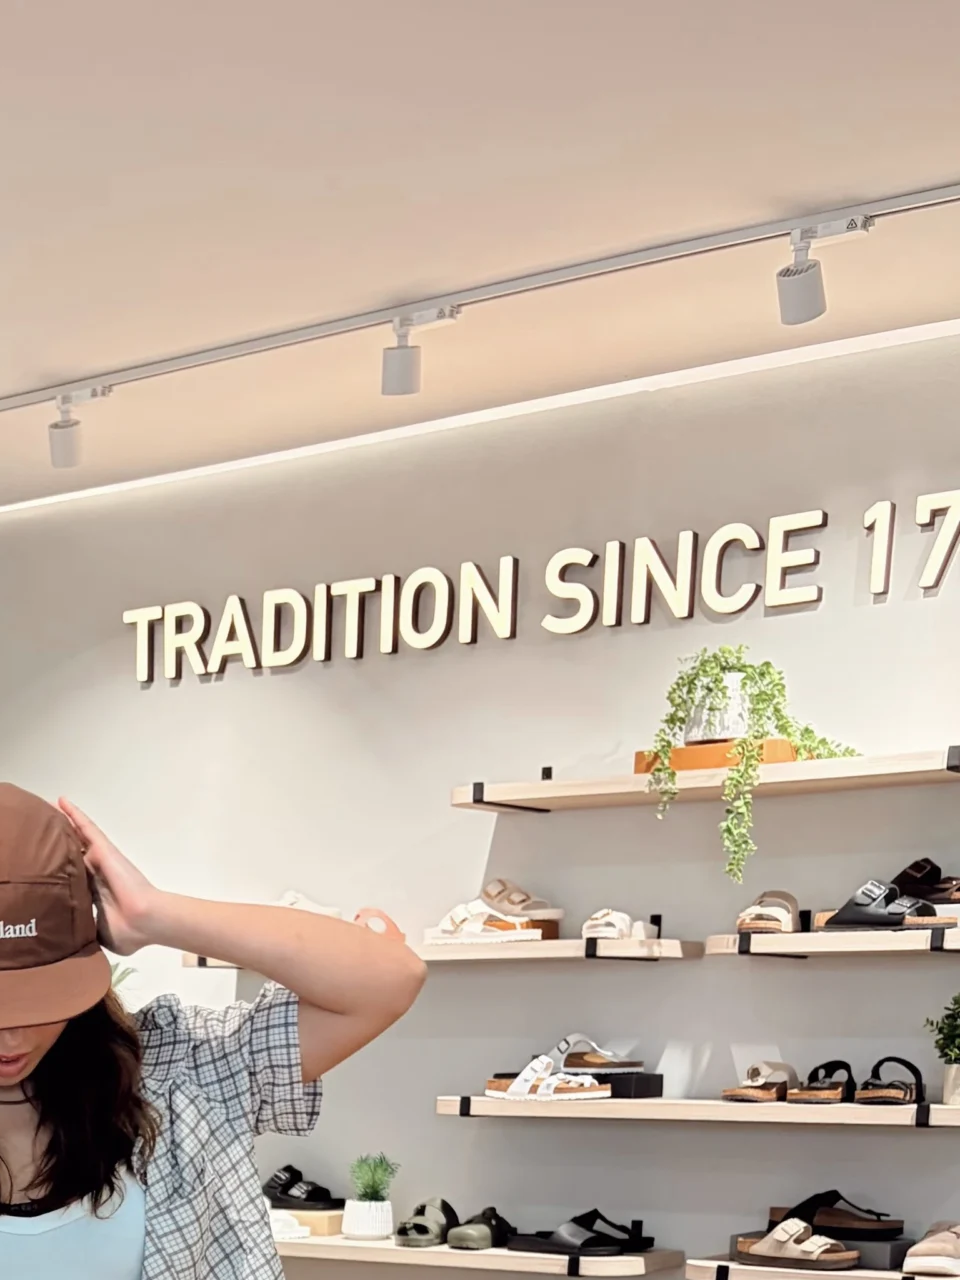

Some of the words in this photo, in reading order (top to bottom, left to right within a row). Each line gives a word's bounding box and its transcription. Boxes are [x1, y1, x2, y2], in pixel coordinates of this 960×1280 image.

[122, 555, 518, 684] TRADITION
[540, 509, 828, 634] SINCE
[863, 489, 960, 595] 17
